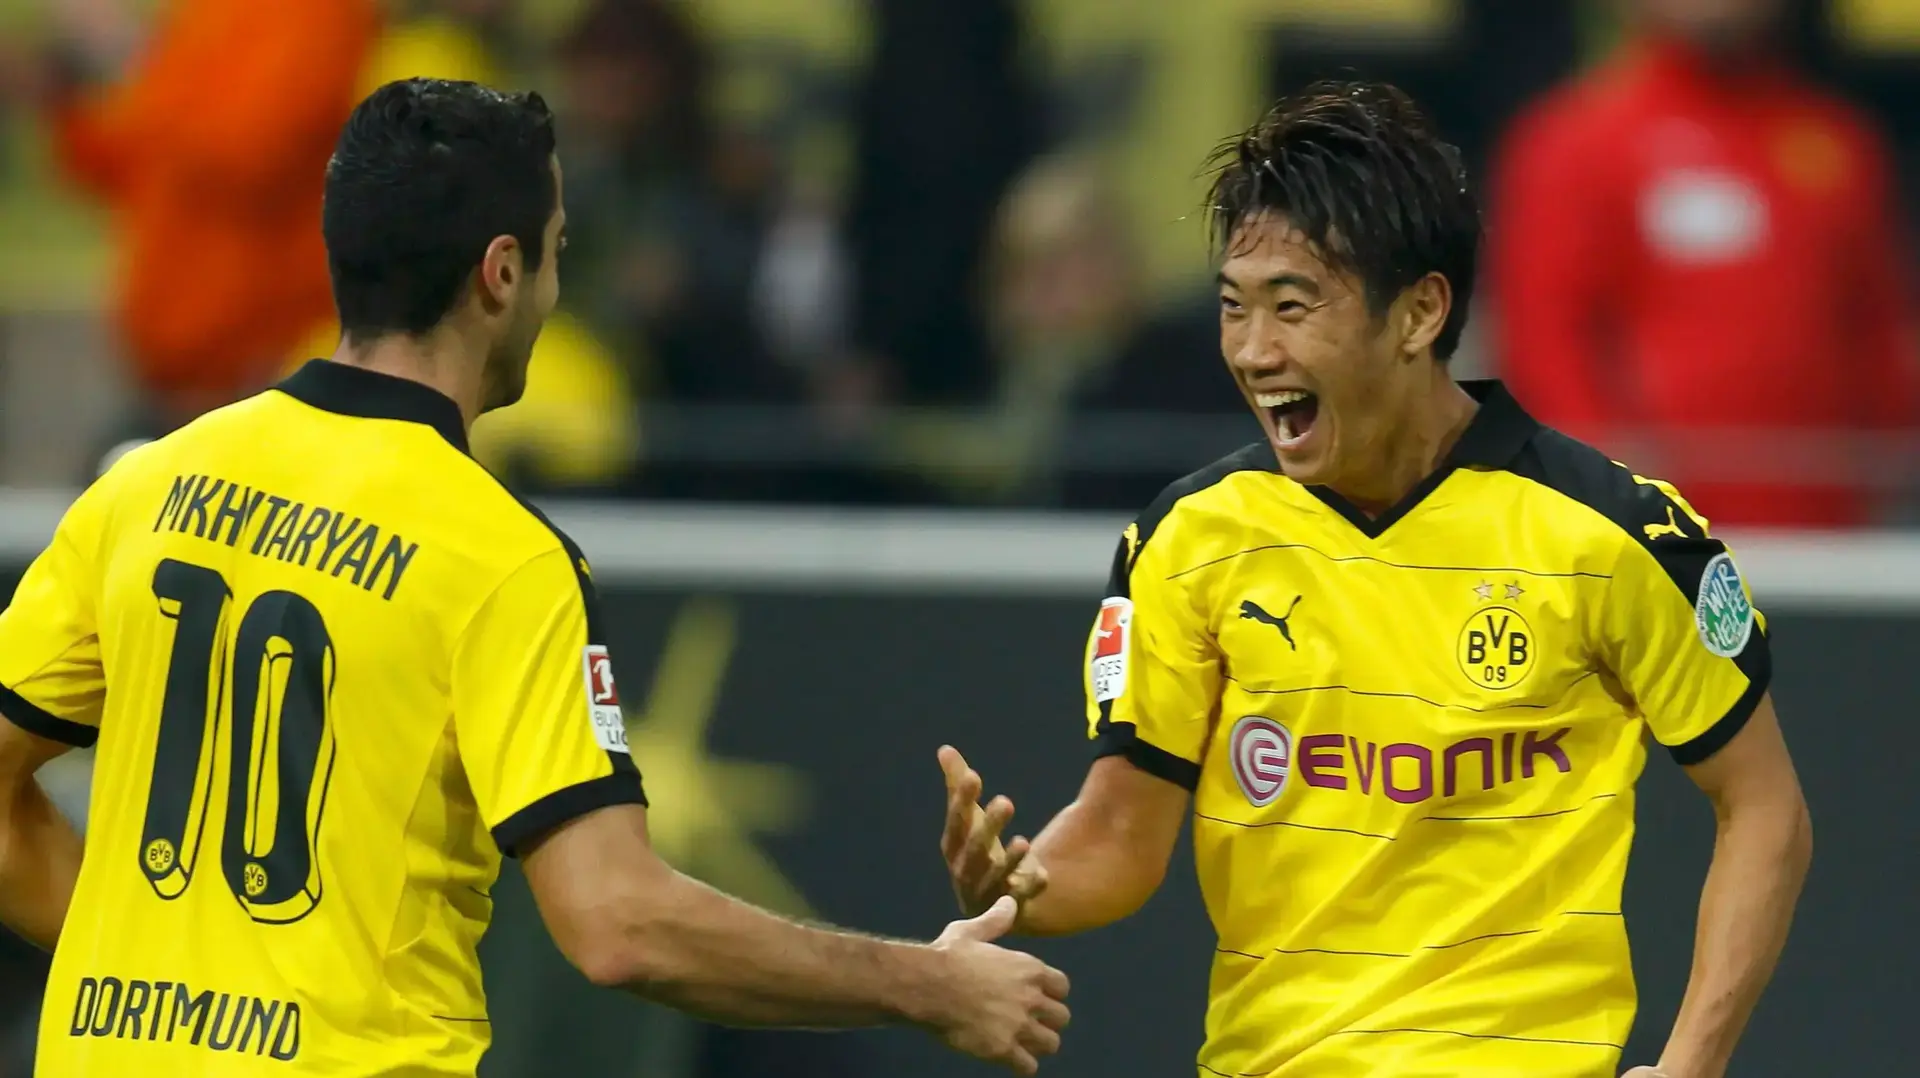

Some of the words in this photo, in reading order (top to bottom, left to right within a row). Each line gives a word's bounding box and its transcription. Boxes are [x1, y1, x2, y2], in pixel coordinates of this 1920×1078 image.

[153, 474, 419, 601] MKHITARYAN
[1705, 563, 1738, 618] WIR
[1467, 614, 1528, 666] BVB
[1484, 665, 1507, 683] 09
[137, 557, 336, 925] 10
[1297, 727, 1572, 804] EVONIK
[150, 843, 172, 864] BVB
[69, 976, 301, 1061] DORTMUND
